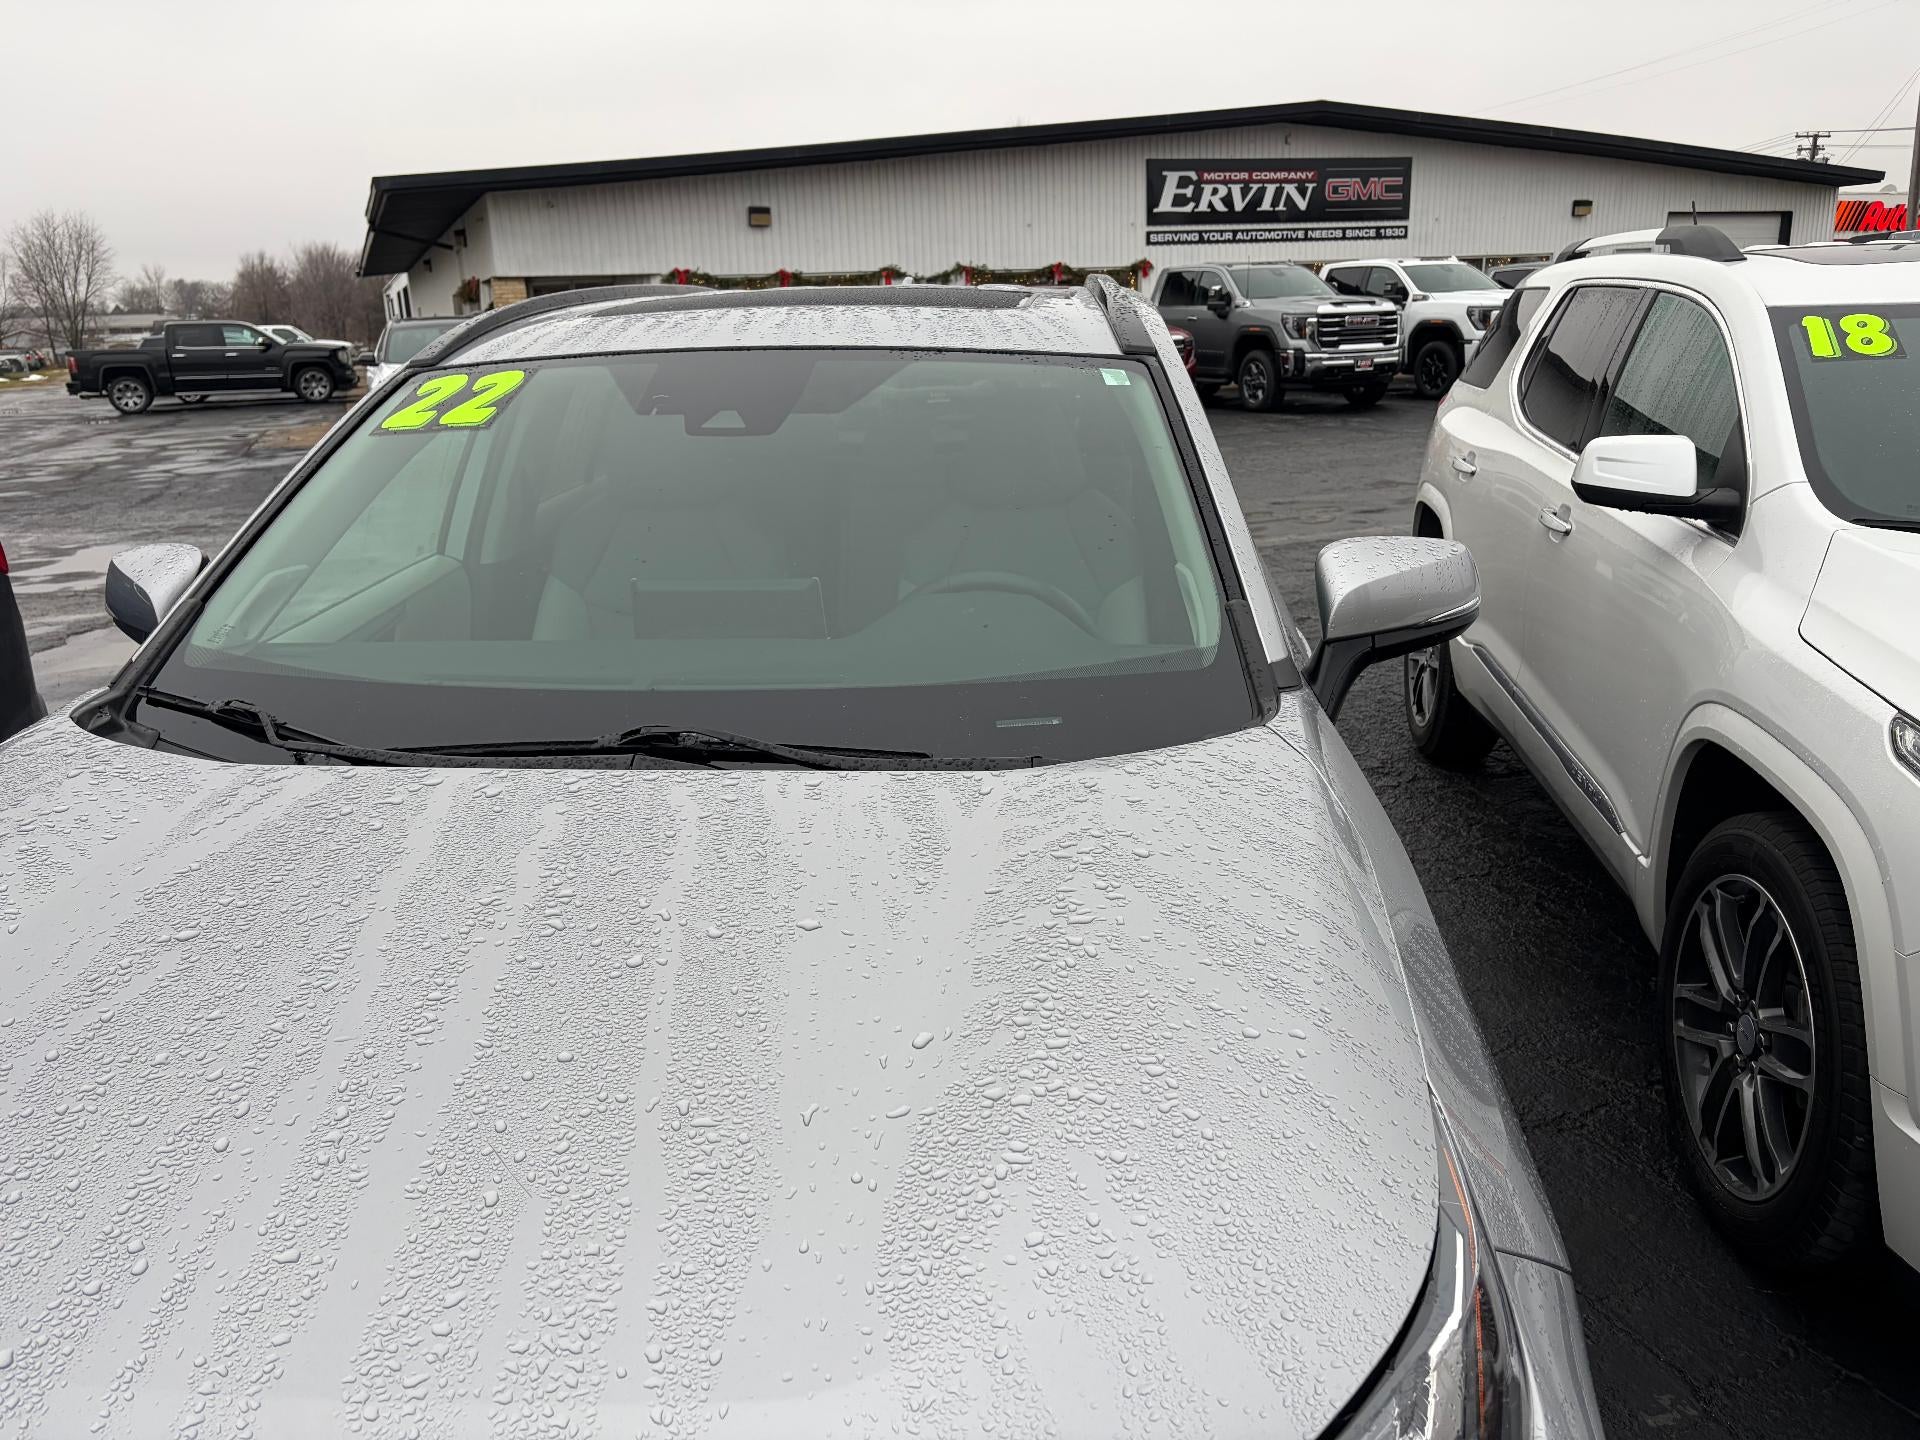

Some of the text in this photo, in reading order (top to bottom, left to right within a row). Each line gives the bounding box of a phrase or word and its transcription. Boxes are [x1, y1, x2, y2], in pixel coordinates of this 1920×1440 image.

[1153, 170, 1403, 213] ERVIN GMC
[1203, 170, 1315, 181] MOTOR COMPANY
[1149, 227, 1405, 242] SERVING YOUR AUTOMOTIVE NEEDS SINCE 1930
[1802, 313, 1898, 358] 18
[381, 370, 525, 431] 22
